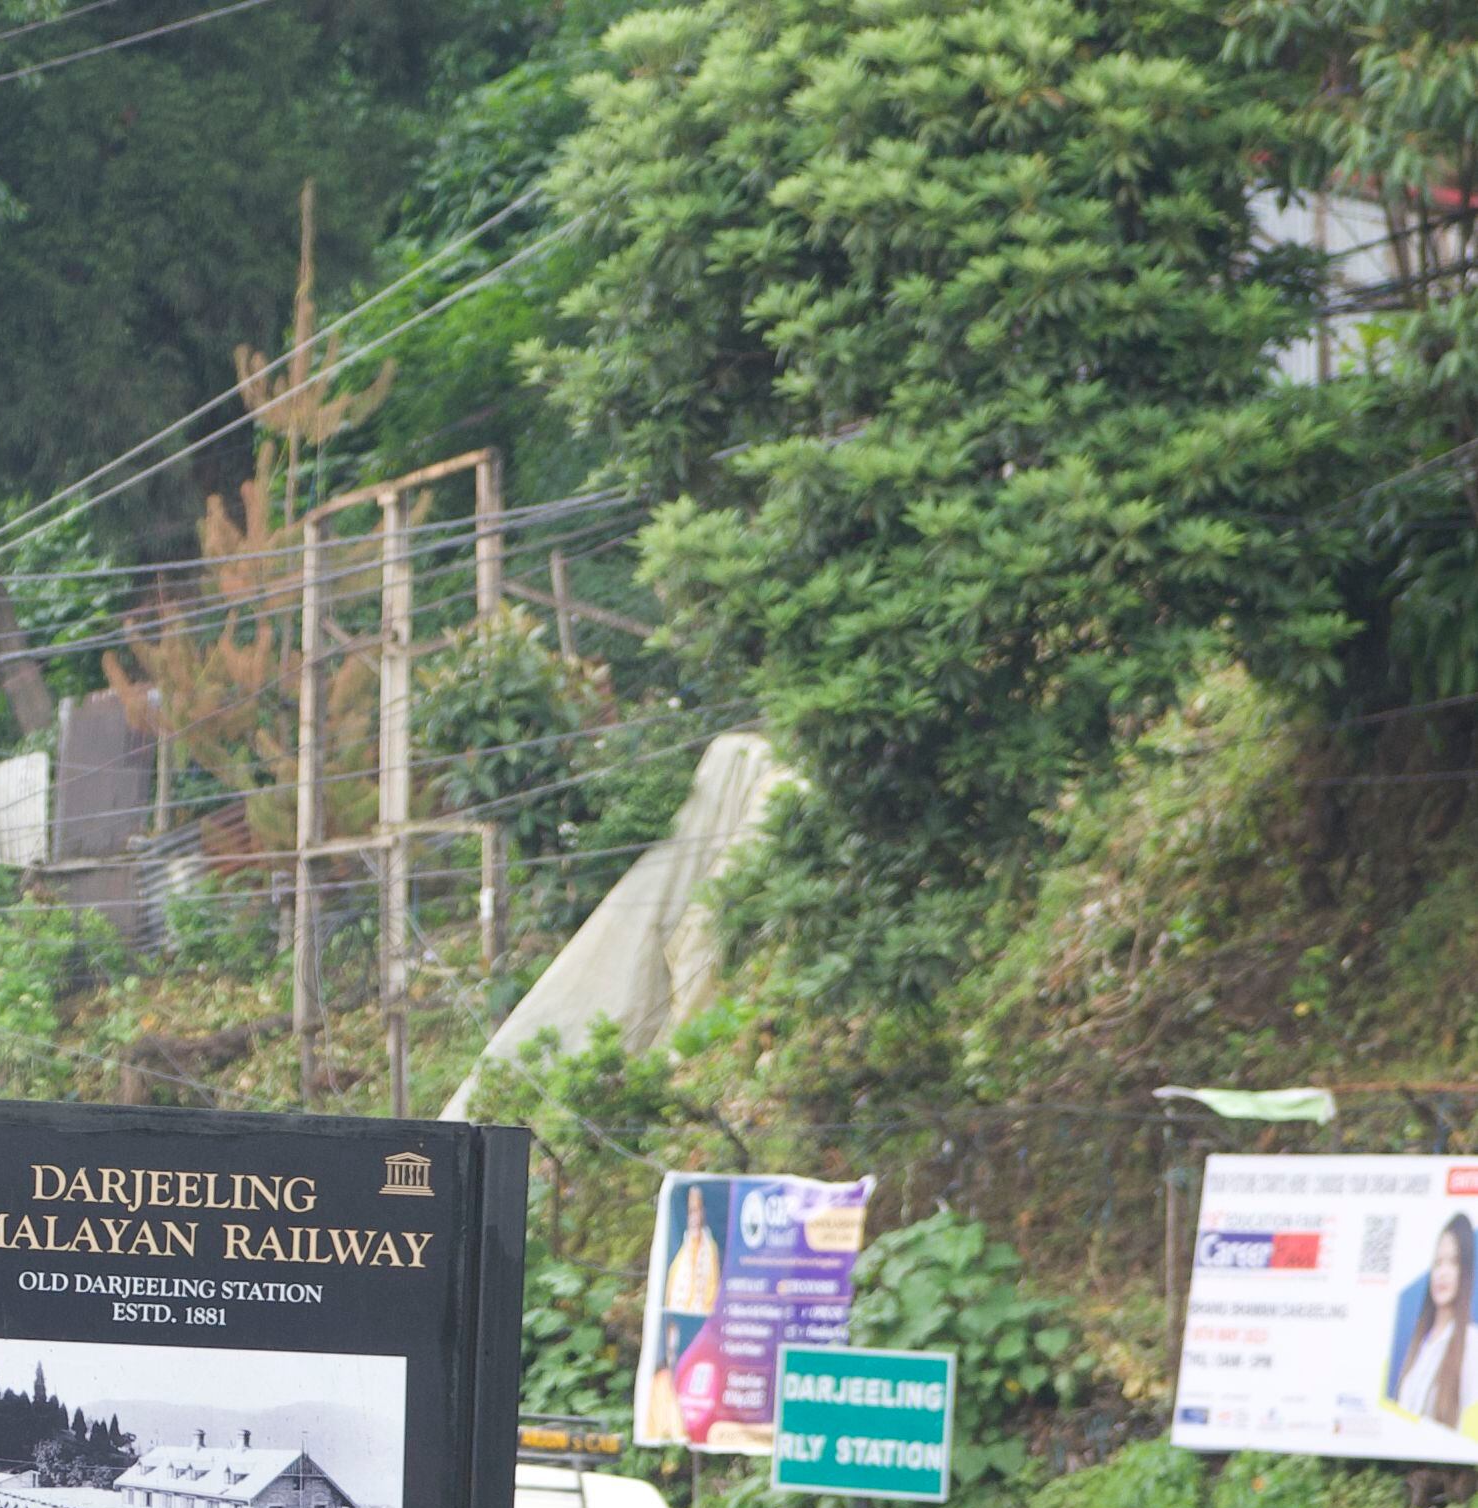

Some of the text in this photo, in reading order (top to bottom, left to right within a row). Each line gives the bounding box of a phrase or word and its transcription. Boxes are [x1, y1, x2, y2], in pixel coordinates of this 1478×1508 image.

[30, 1164, 318, 1213] DARJEELING
[222, 1223, 434, 1268] RAILWAY
[18, 1271, 324, 1303] OLD DARJEELING STATION
[112, 1302, 227, 1326] ESTD. 1881
[784, 1373, 943, 1412] DARJEELING
[778, 1433, 943, 1471] RLY STATION
